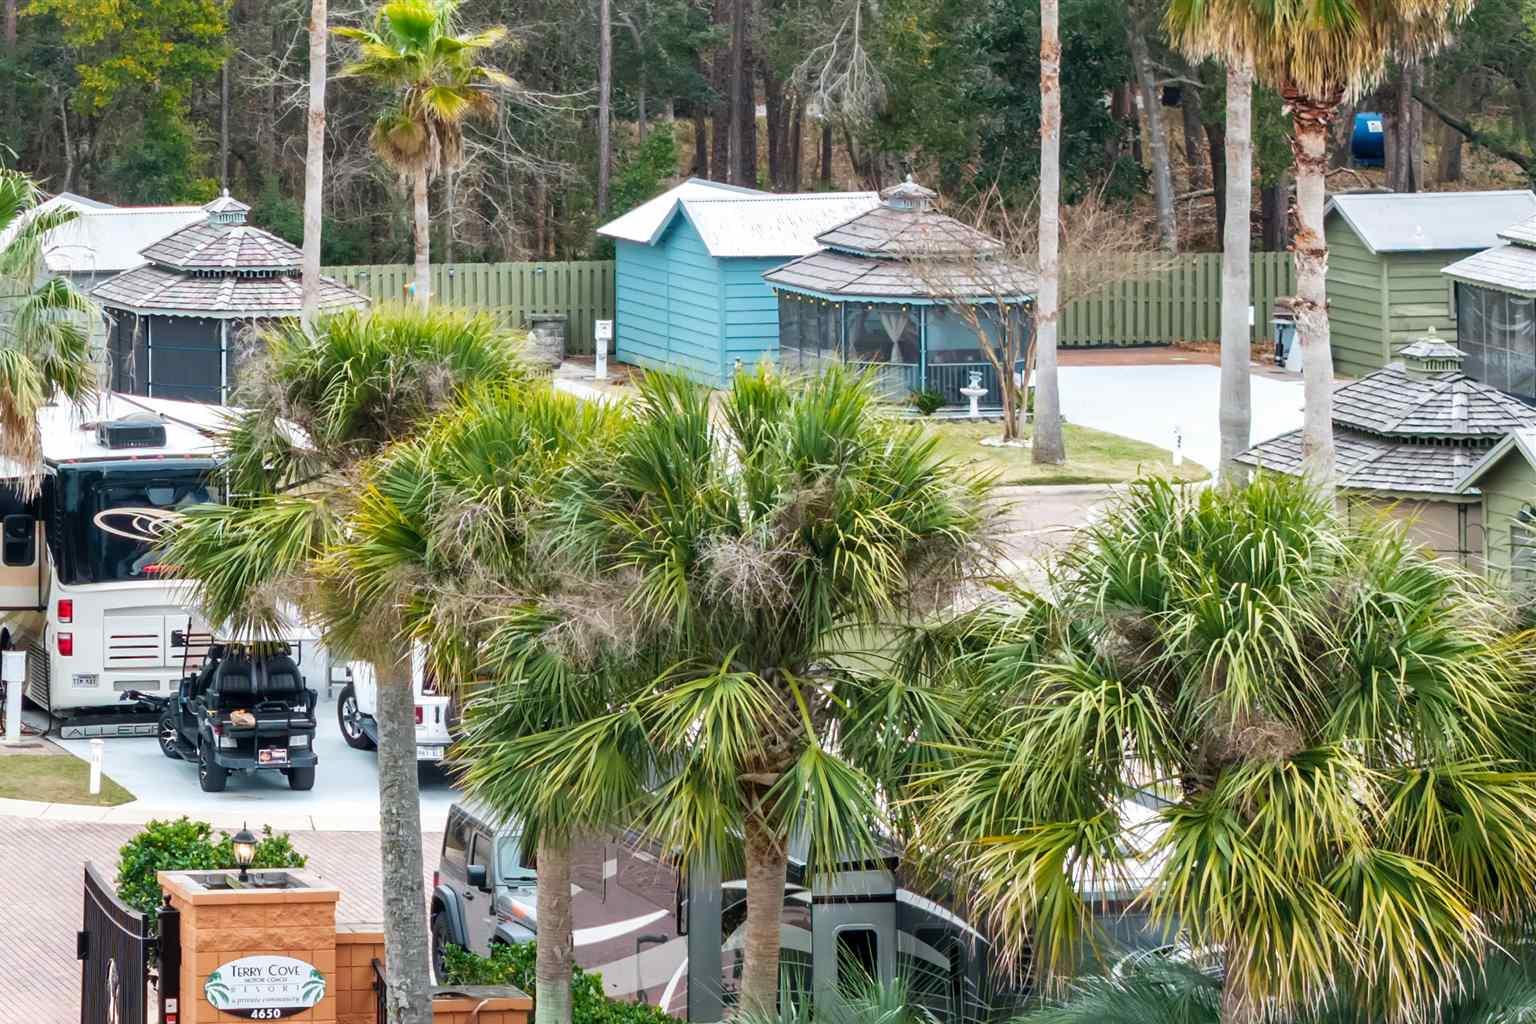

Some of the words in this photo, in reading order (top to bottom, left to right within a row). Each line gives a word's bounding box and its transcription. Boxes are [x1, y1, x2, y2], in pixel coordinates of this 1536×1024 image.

[232, 964, 262, 977] TERRY
[268, 964, 301, 977] COVE
[250, 1008, 281, 1019] 4650
